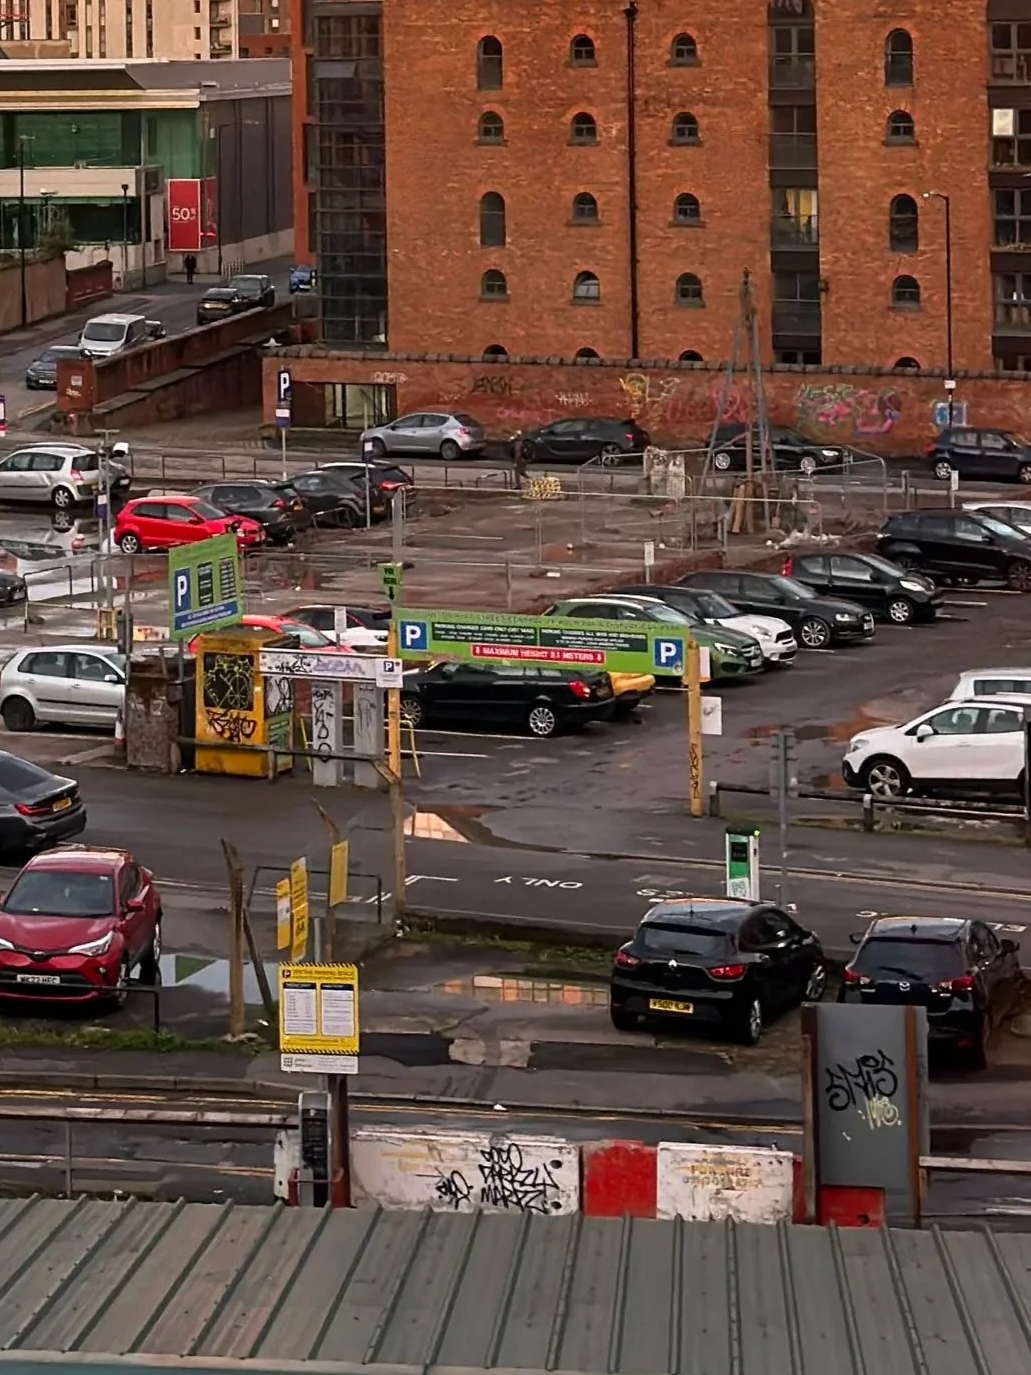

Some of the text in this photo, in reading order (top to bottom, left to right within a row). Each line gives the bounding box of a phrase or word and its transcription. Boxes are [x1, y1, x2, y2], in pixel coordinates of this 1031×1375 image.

[280, 372, 290, 399] P
[177, 575, 188, 607] P
[405, 625, 422, 646] P
[483, 646, 518, 657] MAXIMUM
[520, 649, 548, 659] HEIGHT
[562, 651, 594, 662] METERS
[660, 642, 677, 664] P
[493, 875, 583, 889] ONLY
